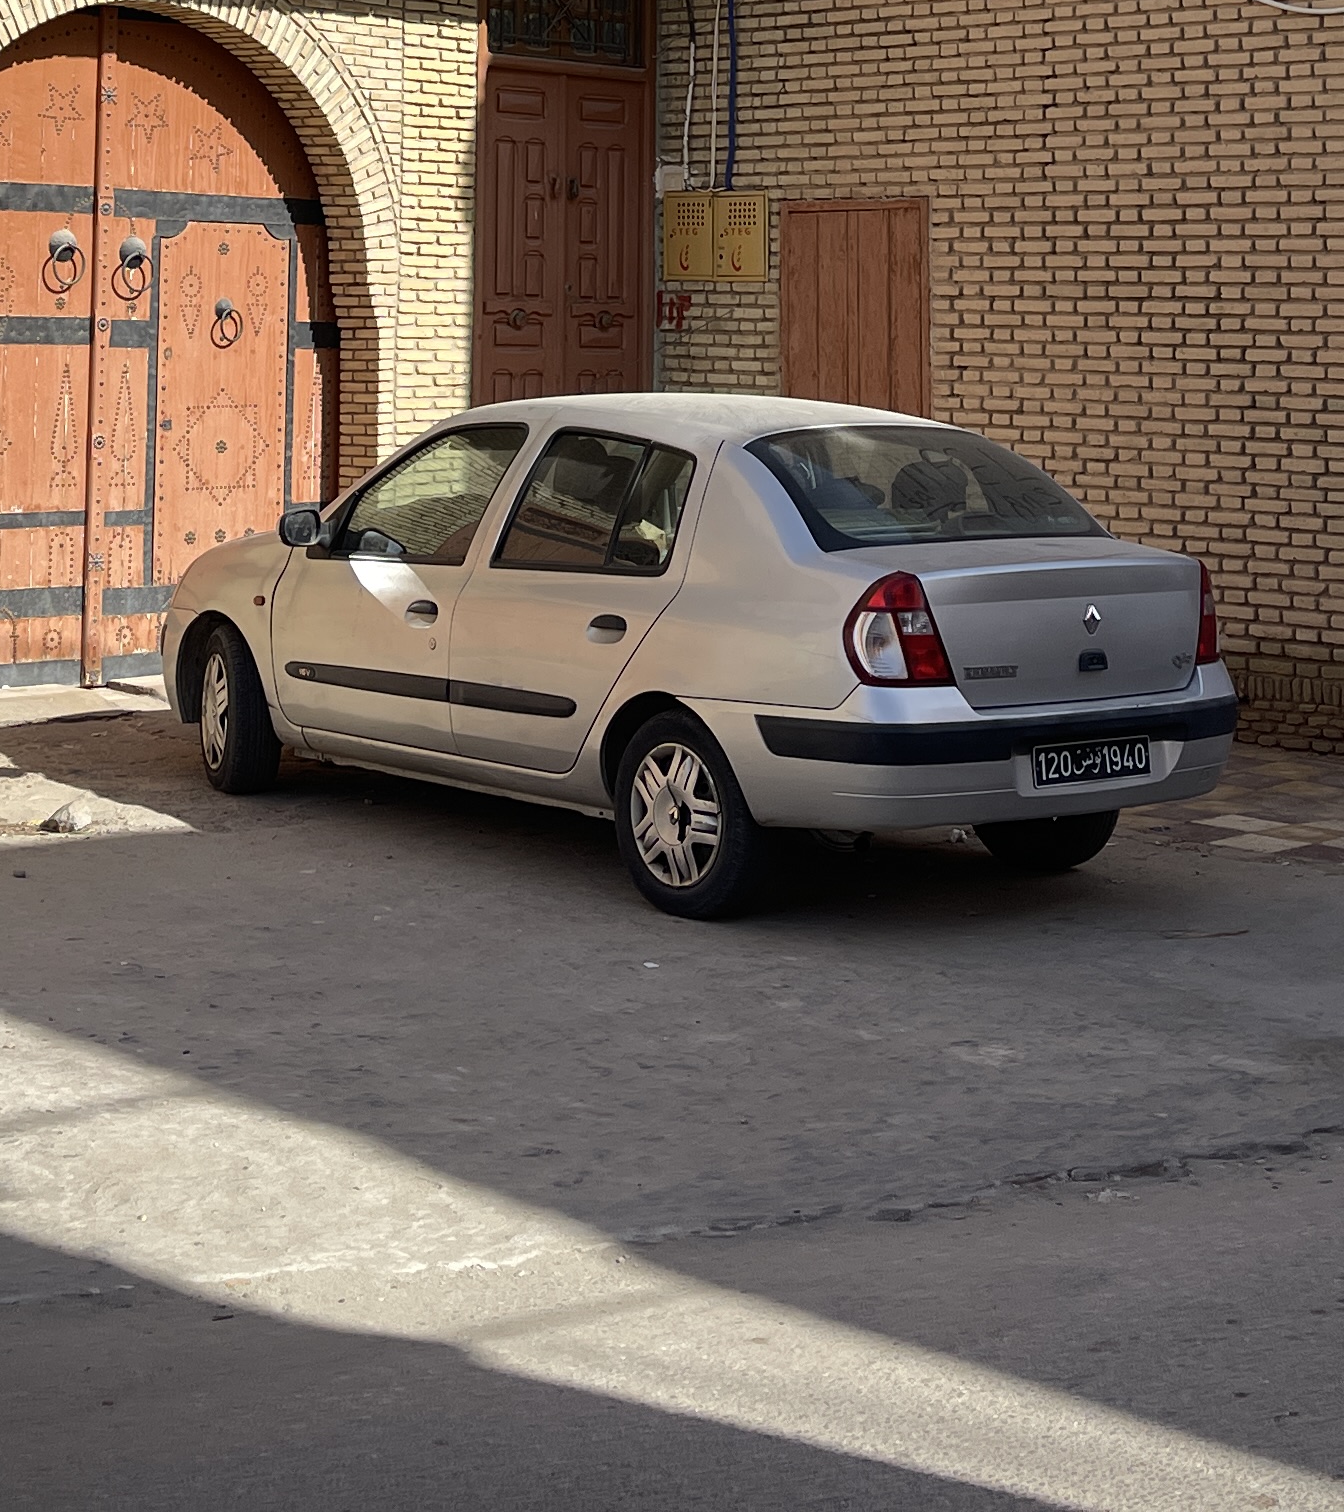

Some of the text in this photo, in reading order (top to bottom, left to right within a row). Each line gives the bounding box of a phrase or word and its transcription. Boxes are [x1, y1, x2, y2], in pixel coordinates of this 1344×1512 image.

[671, 227, 698, 237] STEG
[723, 227, 752, 237] STEG
[1038, 750, 1072, 781] 120
[1102, 743, 1146, 774] 1940
